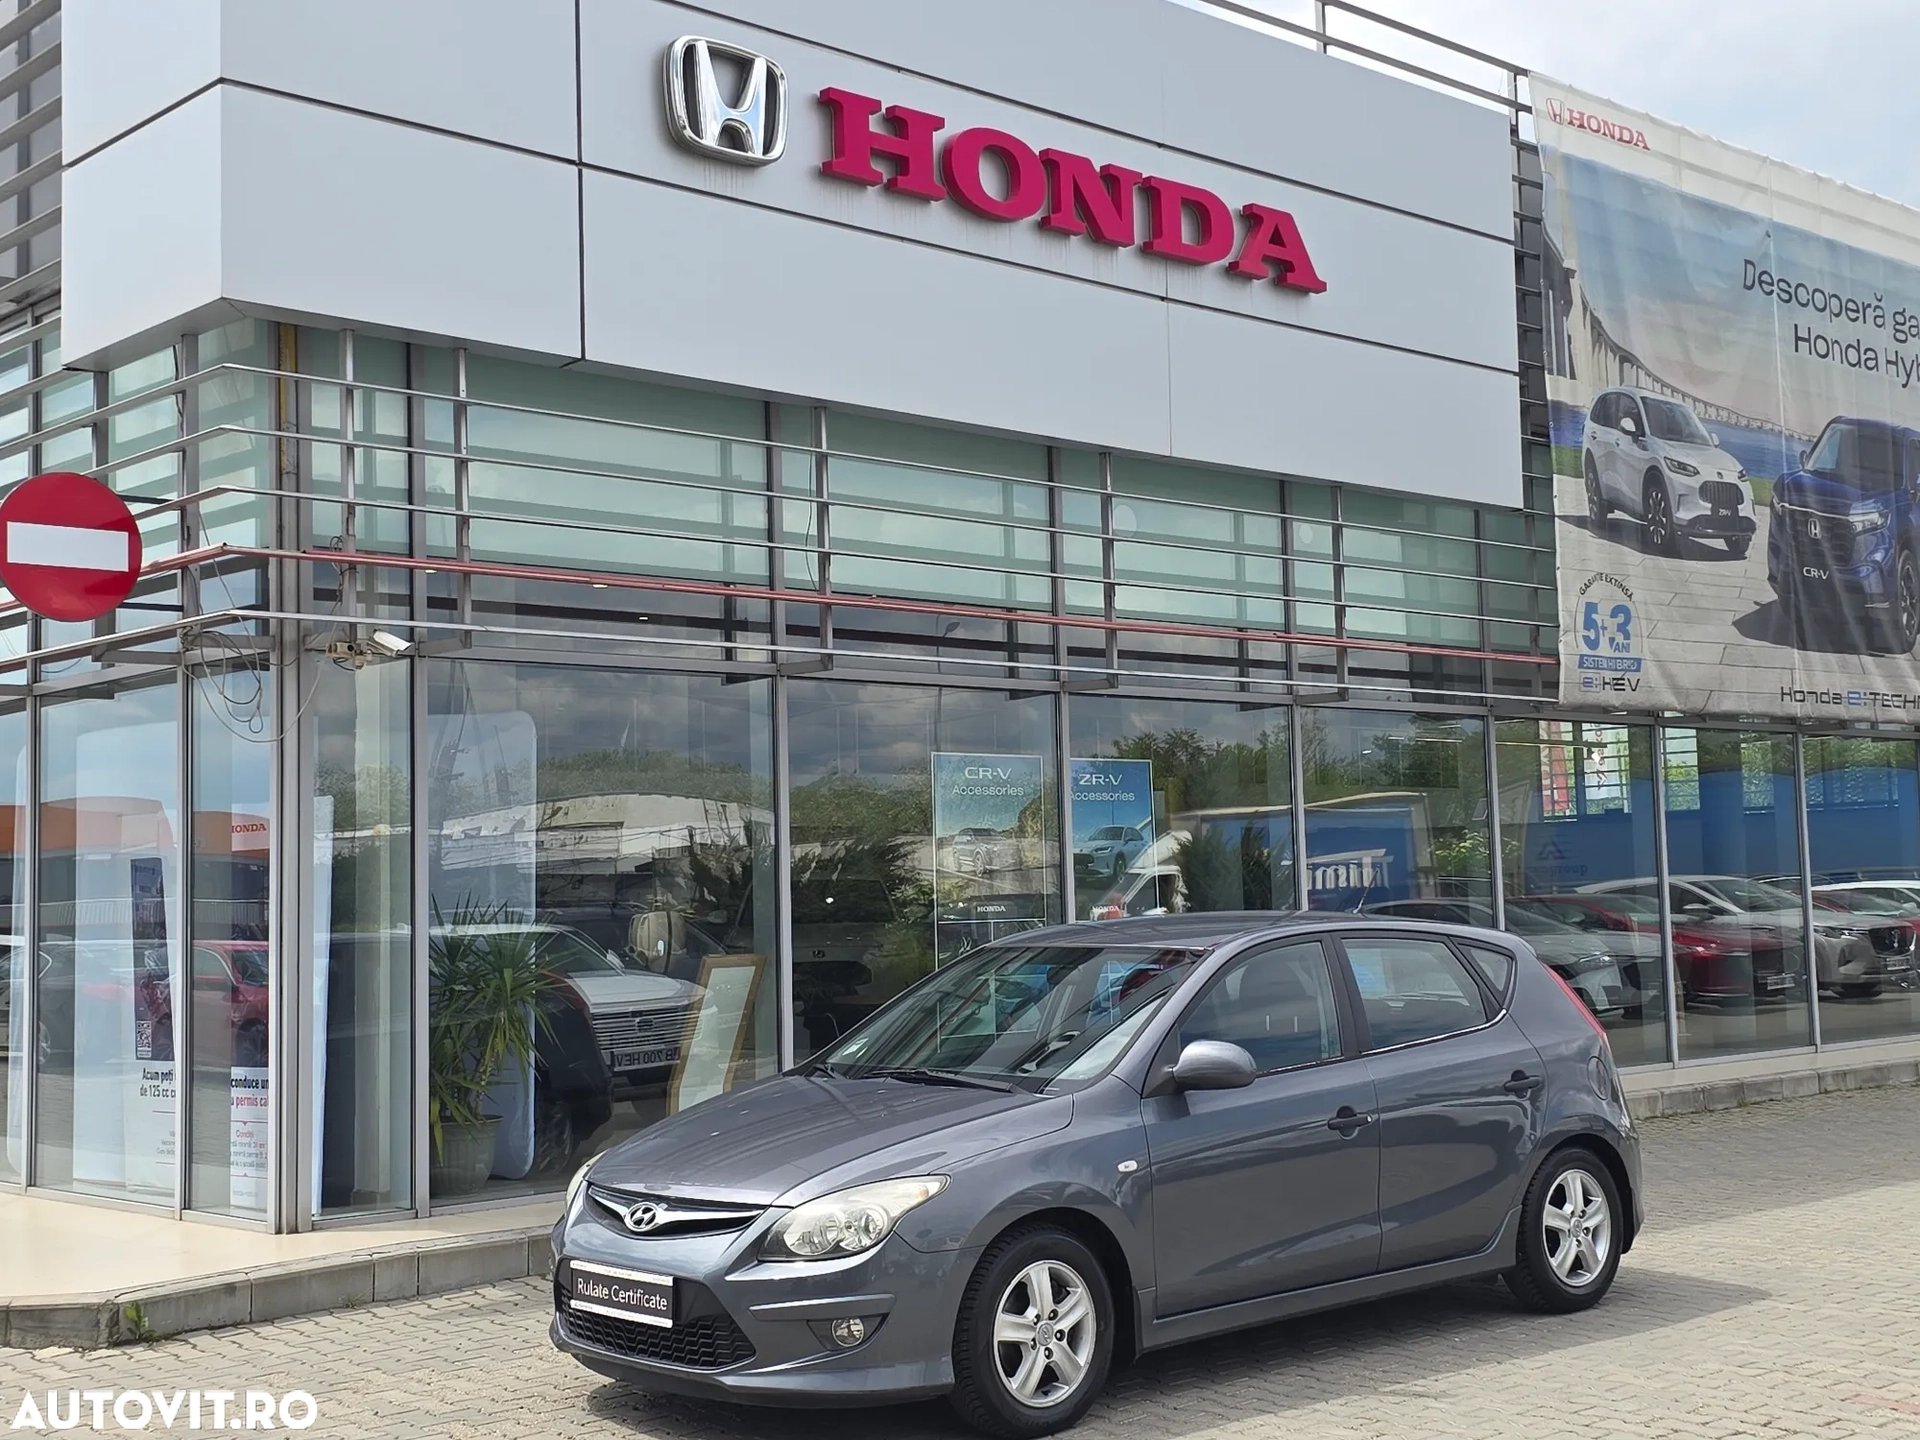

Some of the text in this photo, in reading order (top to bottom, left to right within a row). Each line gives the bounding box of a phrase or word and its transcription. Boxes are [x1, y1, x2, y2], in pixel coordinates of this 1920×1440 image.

[1567, 108, 1650, 151] HONDA
[819, 86, 1328, 294] HONDA
[1743, 258, 1886, 329] Descoperă
[1794, 323, 1879, 372] Honda
[1803, 566, 1829, 580] CR-V
[1613, 641, 1631, 653] ANI
[1780, 686, 1920, 709] Honda e:TECH
[964, 766, 1012, 780] CR-V
[1078, 773, 1123, 785] ZR-V
[952, 784, 1024, 796] Accessories
[977, 905, 1006, 913] HONDA
[142, 1067, 160, 1080] Acum
[230, 1075, 260, 1089] conduce
[140, 1084, 148, 1096] de
[149, 1084, 160, 1097] 125
[577, 1278, 668, 1311] Rulate Certificate
